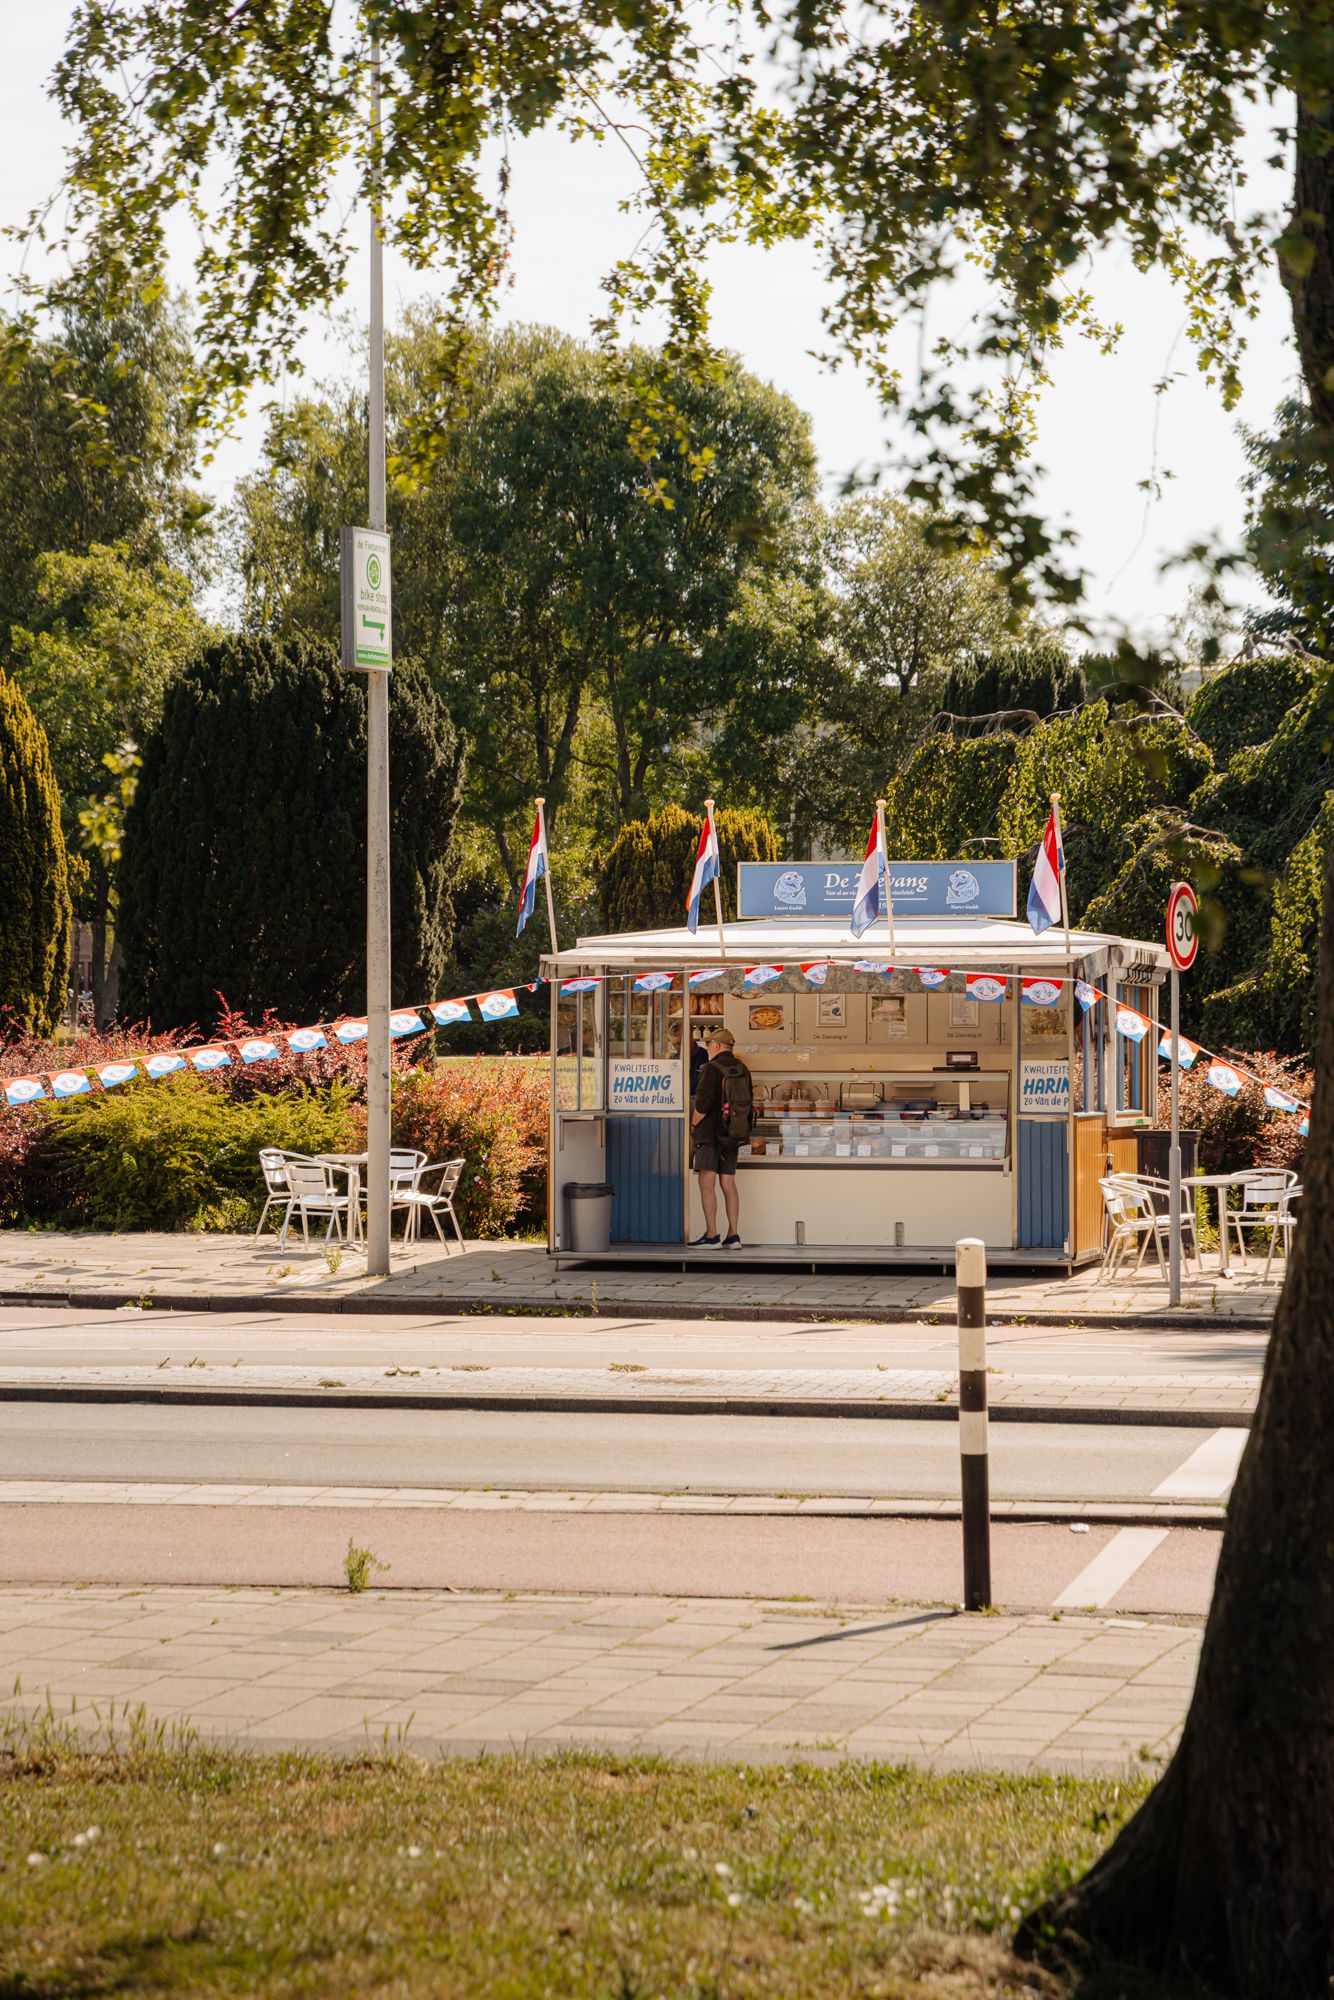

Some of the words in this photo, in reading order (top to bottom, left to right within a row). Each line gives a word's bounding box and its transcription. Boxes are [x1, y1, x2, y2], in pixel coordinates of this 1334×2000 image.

[360, 588, 374, 602] bike
[375, 592, 388, 606] shop
[825, 873, 849, 888] De
[854, 873, 929, 892] Zevang
[1176, 911, 1193, 942] 30
[614, 1064, 660, 1073] KWALITEITS
[613, 1075, 672, 1093] HARING
[614, 1095, 623, 1104] zo
[624, 1094, 639, 1104] van
[639, 1092, 650, 1104] de
[1024, 1097, 1033, 1106] zo
[1035, 1096, 1050, 1106] van
[1050, 1095, 1062, 1106] de
